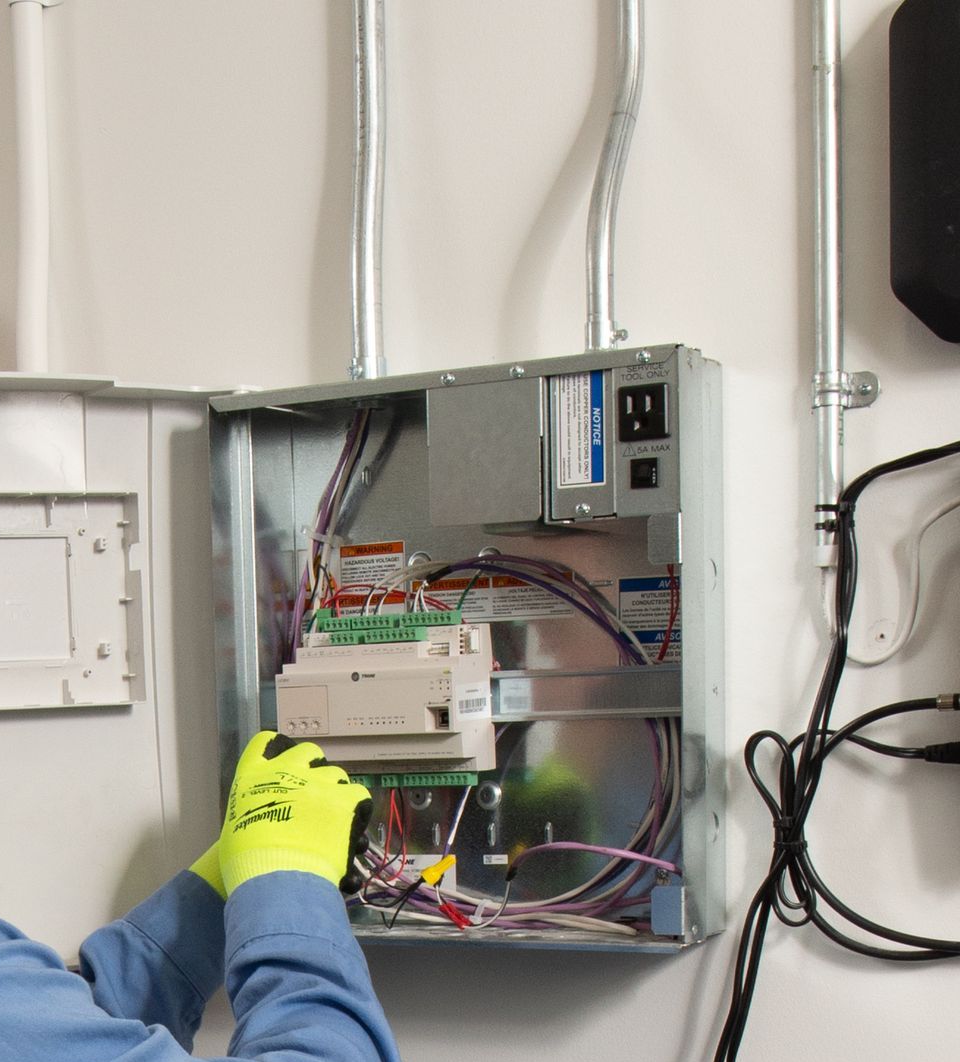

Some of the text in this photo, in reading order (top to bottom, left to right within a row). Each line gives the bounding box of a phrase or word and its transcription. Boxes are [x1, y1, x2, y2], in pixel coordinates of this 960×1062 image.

[626, 362, 665, 373] SERVICE
[620, 368, 671, 381] TOOL ONLY
[592, 407, 601, 446] NOTICE
[637, 444, 671, 454] 5A MAX
[356, 545, 392, 554] WARNING
[655, 632, 680, 641] AVSO
[233, 805, 294, 834] Milwaukee
